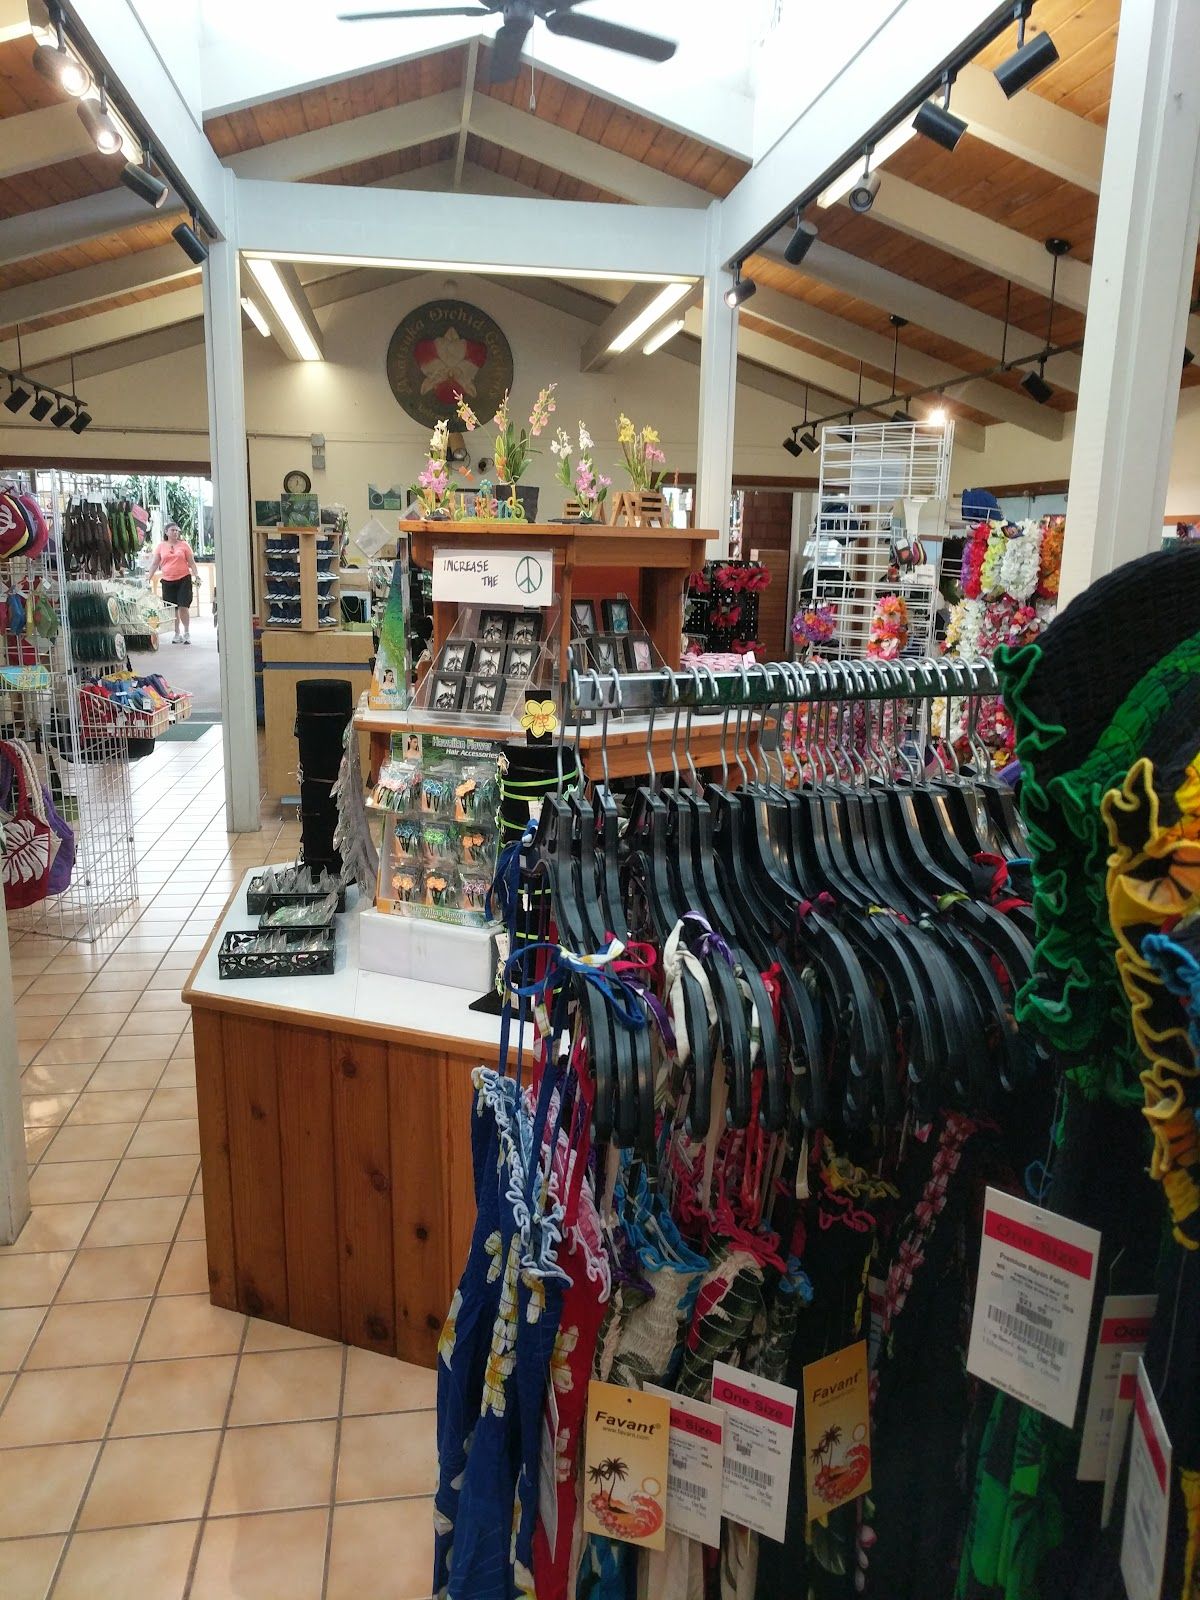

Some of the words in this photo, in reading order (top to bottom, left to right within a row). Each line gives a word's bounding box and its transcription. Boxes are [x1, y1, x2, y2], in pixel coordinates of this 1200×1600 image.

[429, 306, 486, 331] Orchid
[443, 559, 489, 573] INCREASE
[481, 575, 499, 588] THE
[432, 736, 466, 750] Hawaiian
[466, 739, 493, 752] Flower
[446, 748, 460, 756] Hair
[460, 750, 499, 759] Accessories
[996, 1221, 1033, 1248] One
[1040, 1240, 1078, 1268] Size
[998, 1250, 1027, 1269] Premium
[1027, 1264, 1048, 1280] Rayon
[1048, 1273, 1069, 1289] Fabric
[812, 1373, 859, 1404] Favant
[722, 1388, 750, 1407] One
[755, 1399, 784, 1420] Size
[595, 1410, 657, 1435] Favant
[686, 1420, 713, 1437] Size
[602, 1426, 651, 1441] www.favant.com
